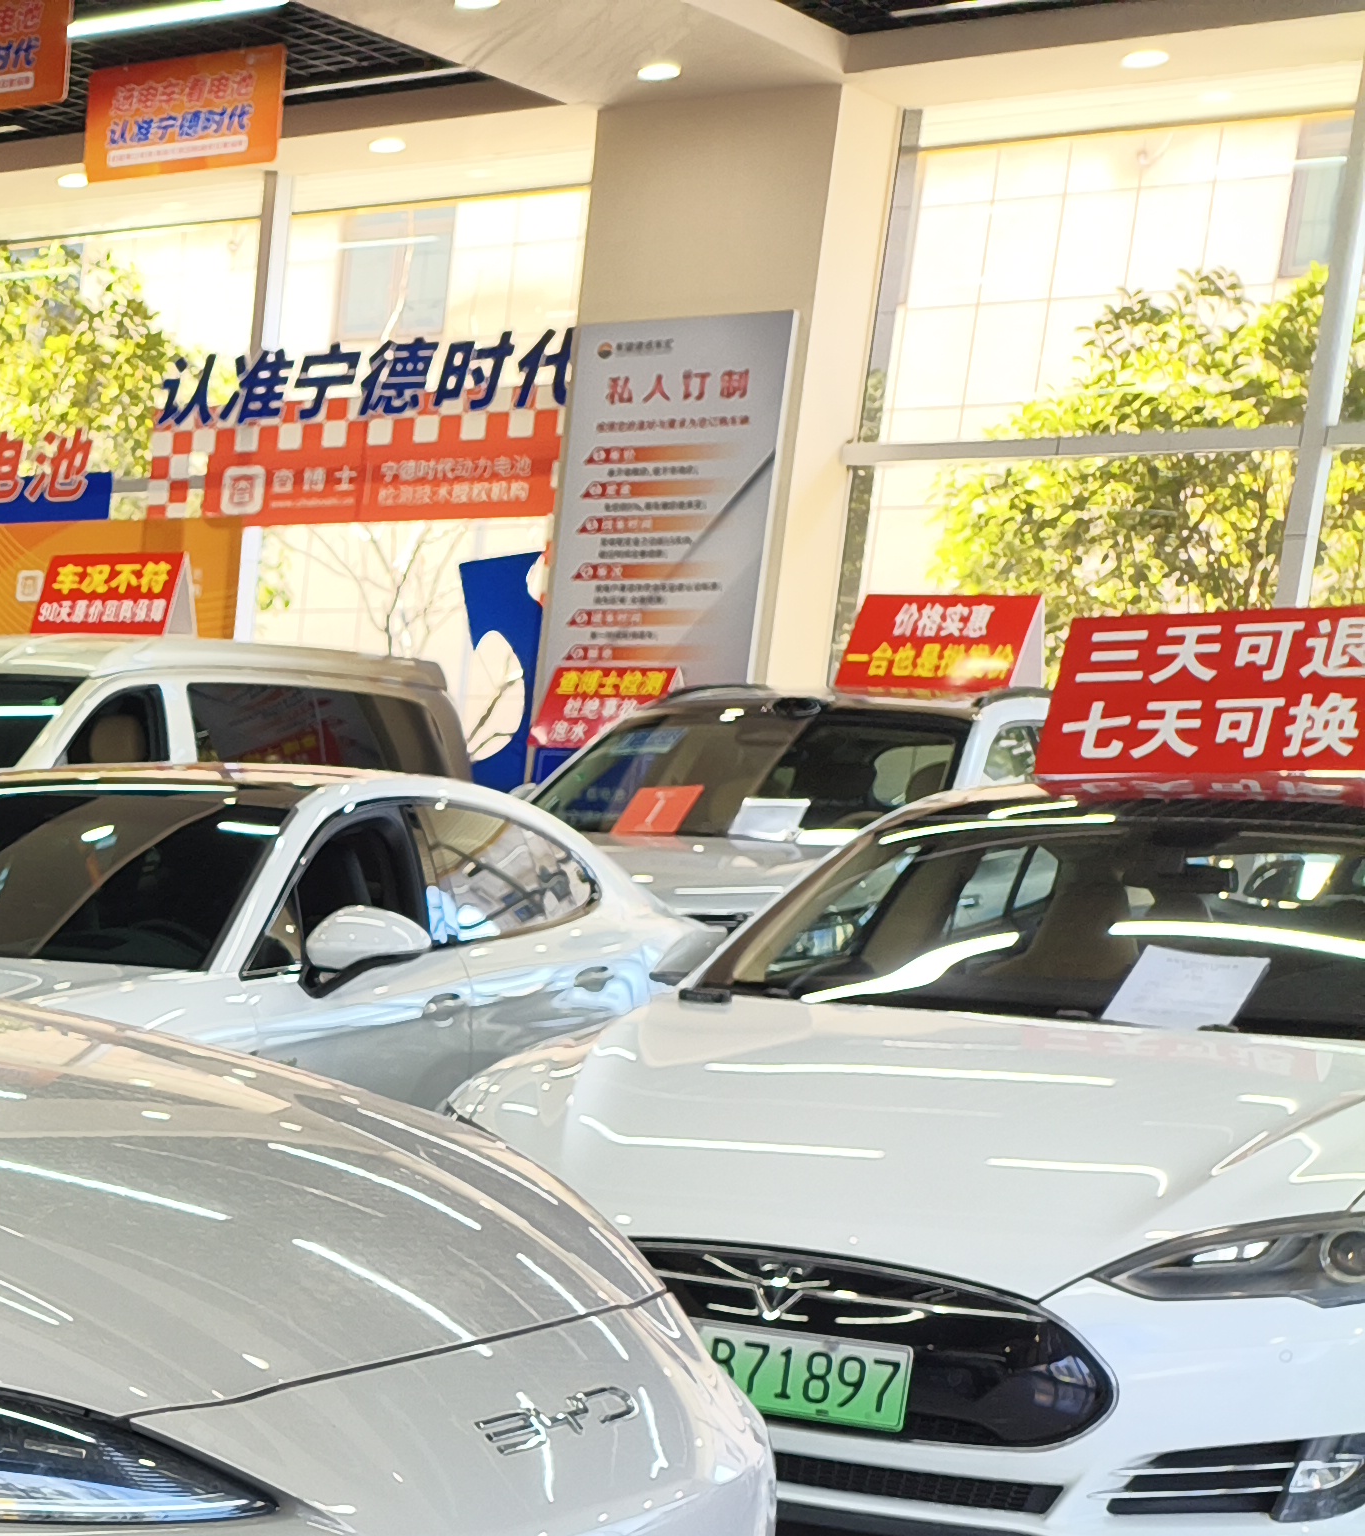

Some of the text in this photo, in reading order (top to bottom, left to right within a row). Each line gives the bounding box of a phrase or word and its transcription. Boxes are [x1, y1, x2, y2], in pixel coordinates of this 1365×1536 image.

[158, 326, 575, 425] 认准宁德时代
[605, 368, 751, 405] 私人订制
[379, 455, 533, 484] 宁德时代动力电池
[51, 560, 172, 596] 车况不符
[891, 602, 996, 639] 价格实惠
[1074, 616, 1365, 684] 三天可退
[555, 669, 668, 696] 查博士检测
[1061, 691, 1360, 760] 七天可换
